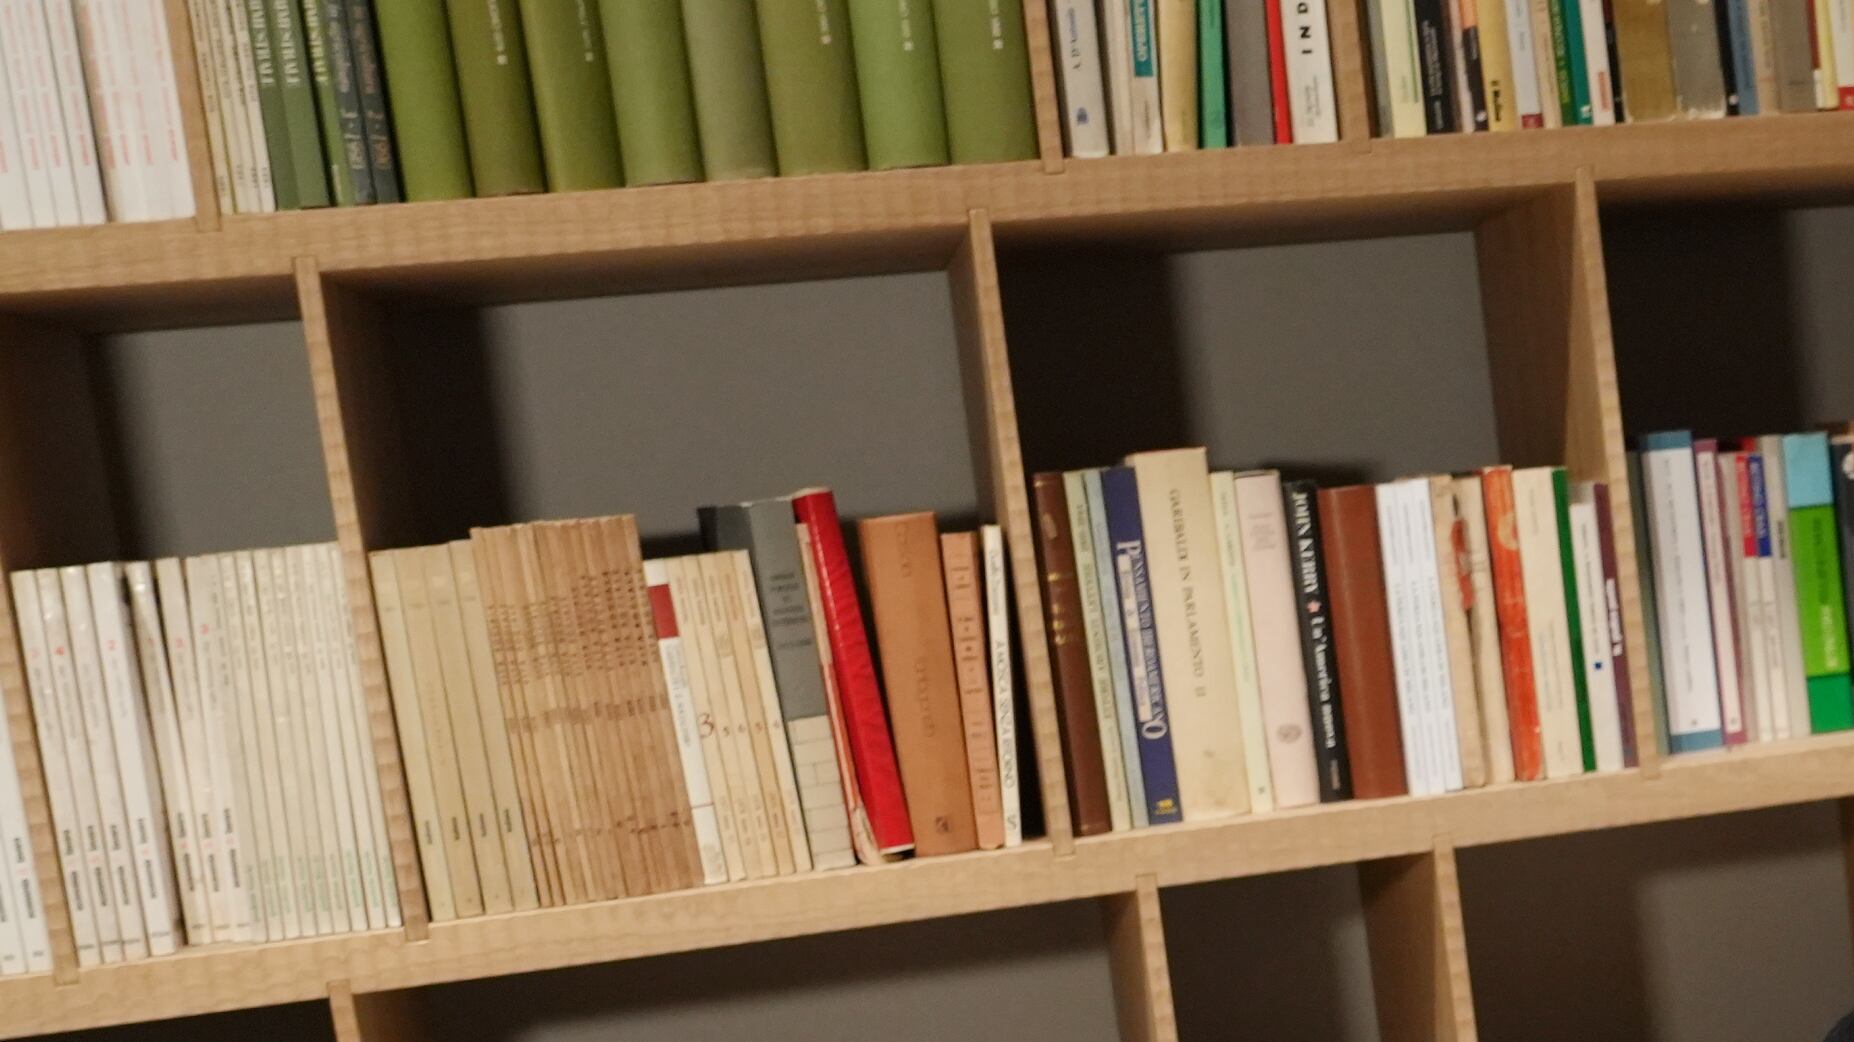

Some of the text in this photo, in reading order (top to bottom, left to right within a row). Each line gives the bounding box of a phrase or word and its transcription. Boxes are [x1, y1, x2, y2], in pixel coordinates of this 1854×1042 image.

[1168, 488, 1188, 562] GARIBALDI
[1292, 491, 1317, 593] JOHN KERRY
[1179, 565, 1191, 581] IN
[1181, 586, 1205, 678] PARLAMENTO
